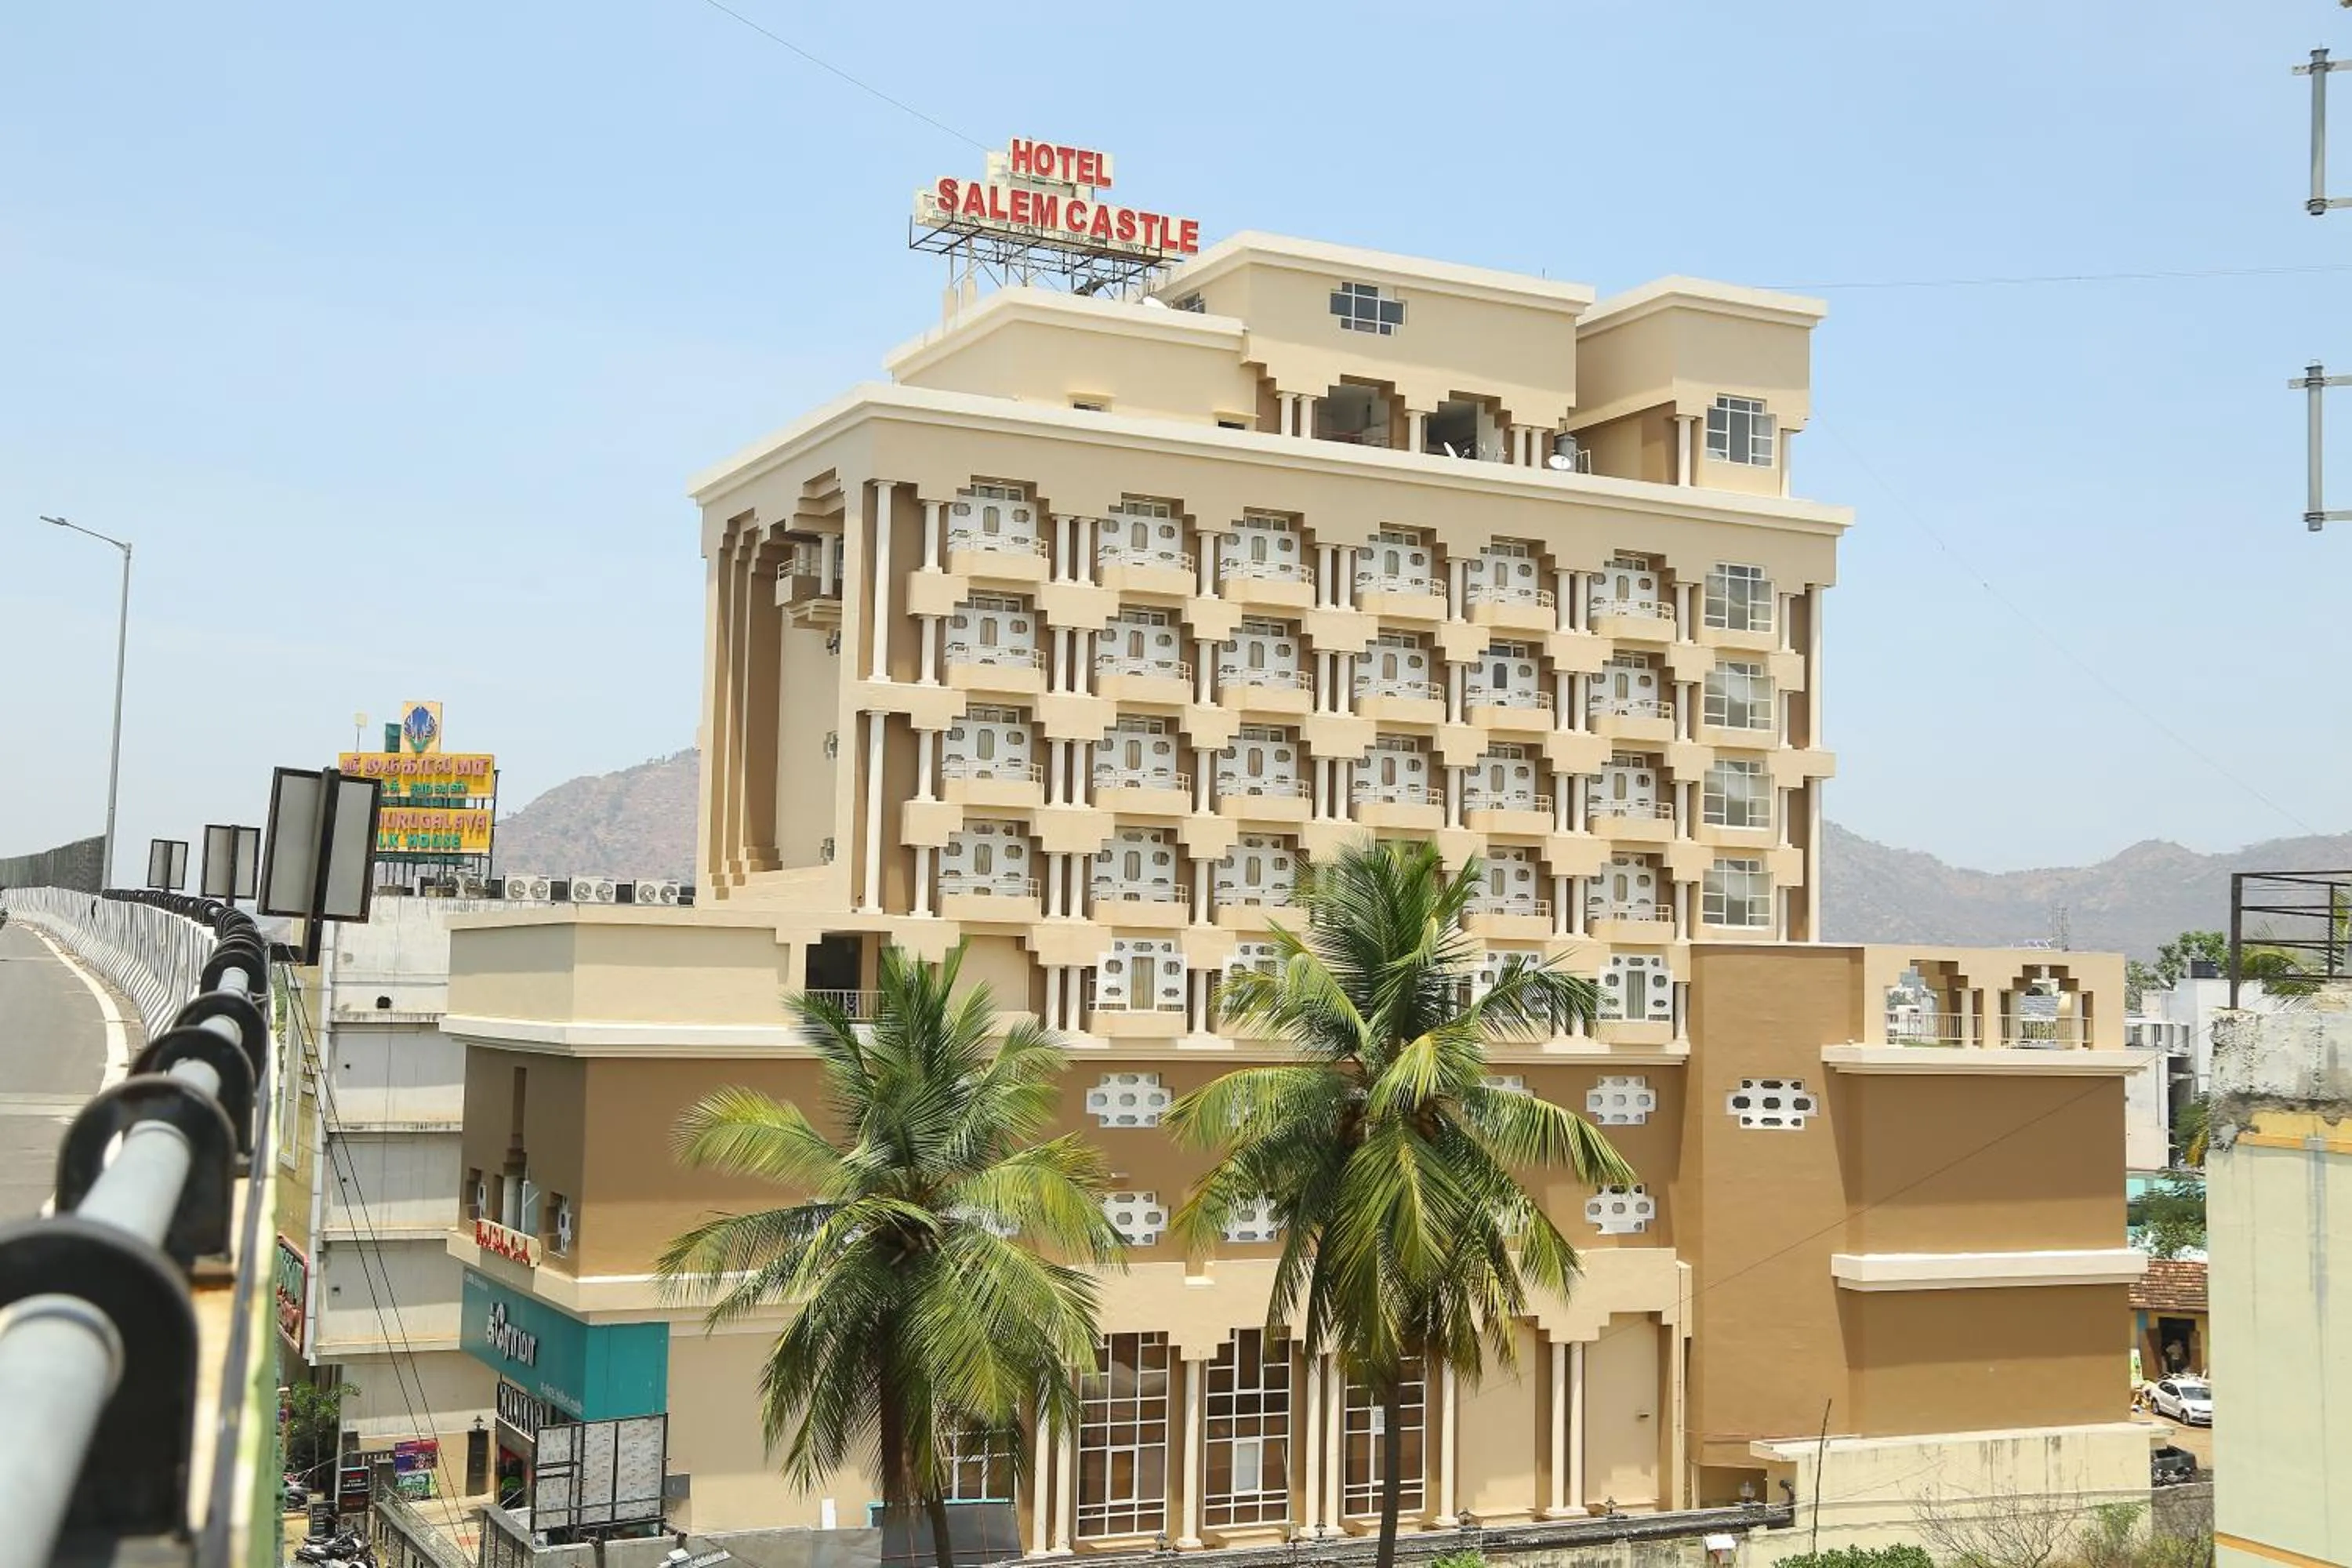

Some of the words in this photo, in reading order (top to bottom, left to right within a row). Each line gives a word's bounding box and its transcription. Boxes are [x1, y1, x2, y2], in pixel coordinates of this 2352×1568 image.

[1012, 139, 1112, 187] HOTEL
[938, 178, 1058, 230] SALEM
[1065, 201, 1199, 252] CASTLE
[407, 833, 462, 850] HOUSE
